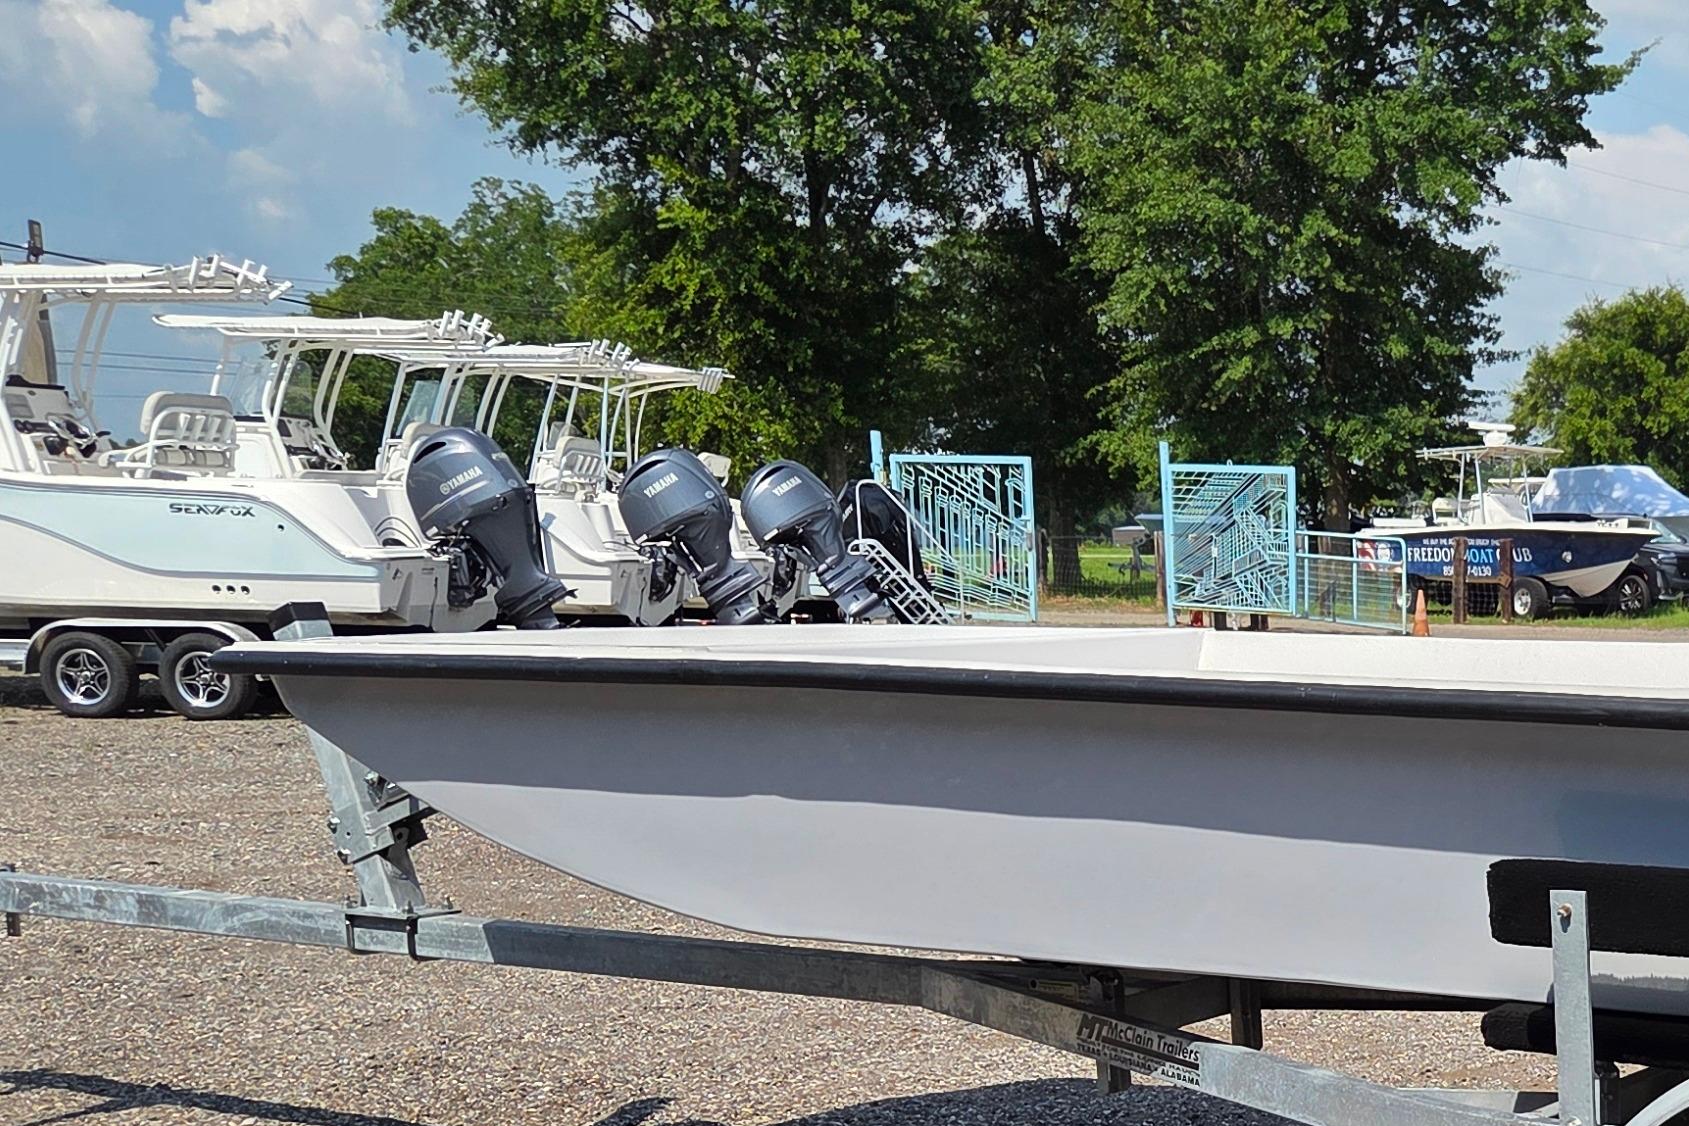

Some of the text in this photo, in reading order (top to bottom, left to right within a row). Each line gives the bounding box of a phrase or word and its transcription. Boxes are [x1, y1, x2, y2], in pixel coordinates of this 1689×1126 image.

[447, 465, 483, 490] YAMAHA
[643, 472, 679, 498] YAMAHA
[772, 475, 802, 497] YAMAHA
[1107, 1021, 1154, 1049] McClain
[1156, 1034, 1200, 1062] Trailers
[1160, 1067, 1200, 1087] ALABAMA
